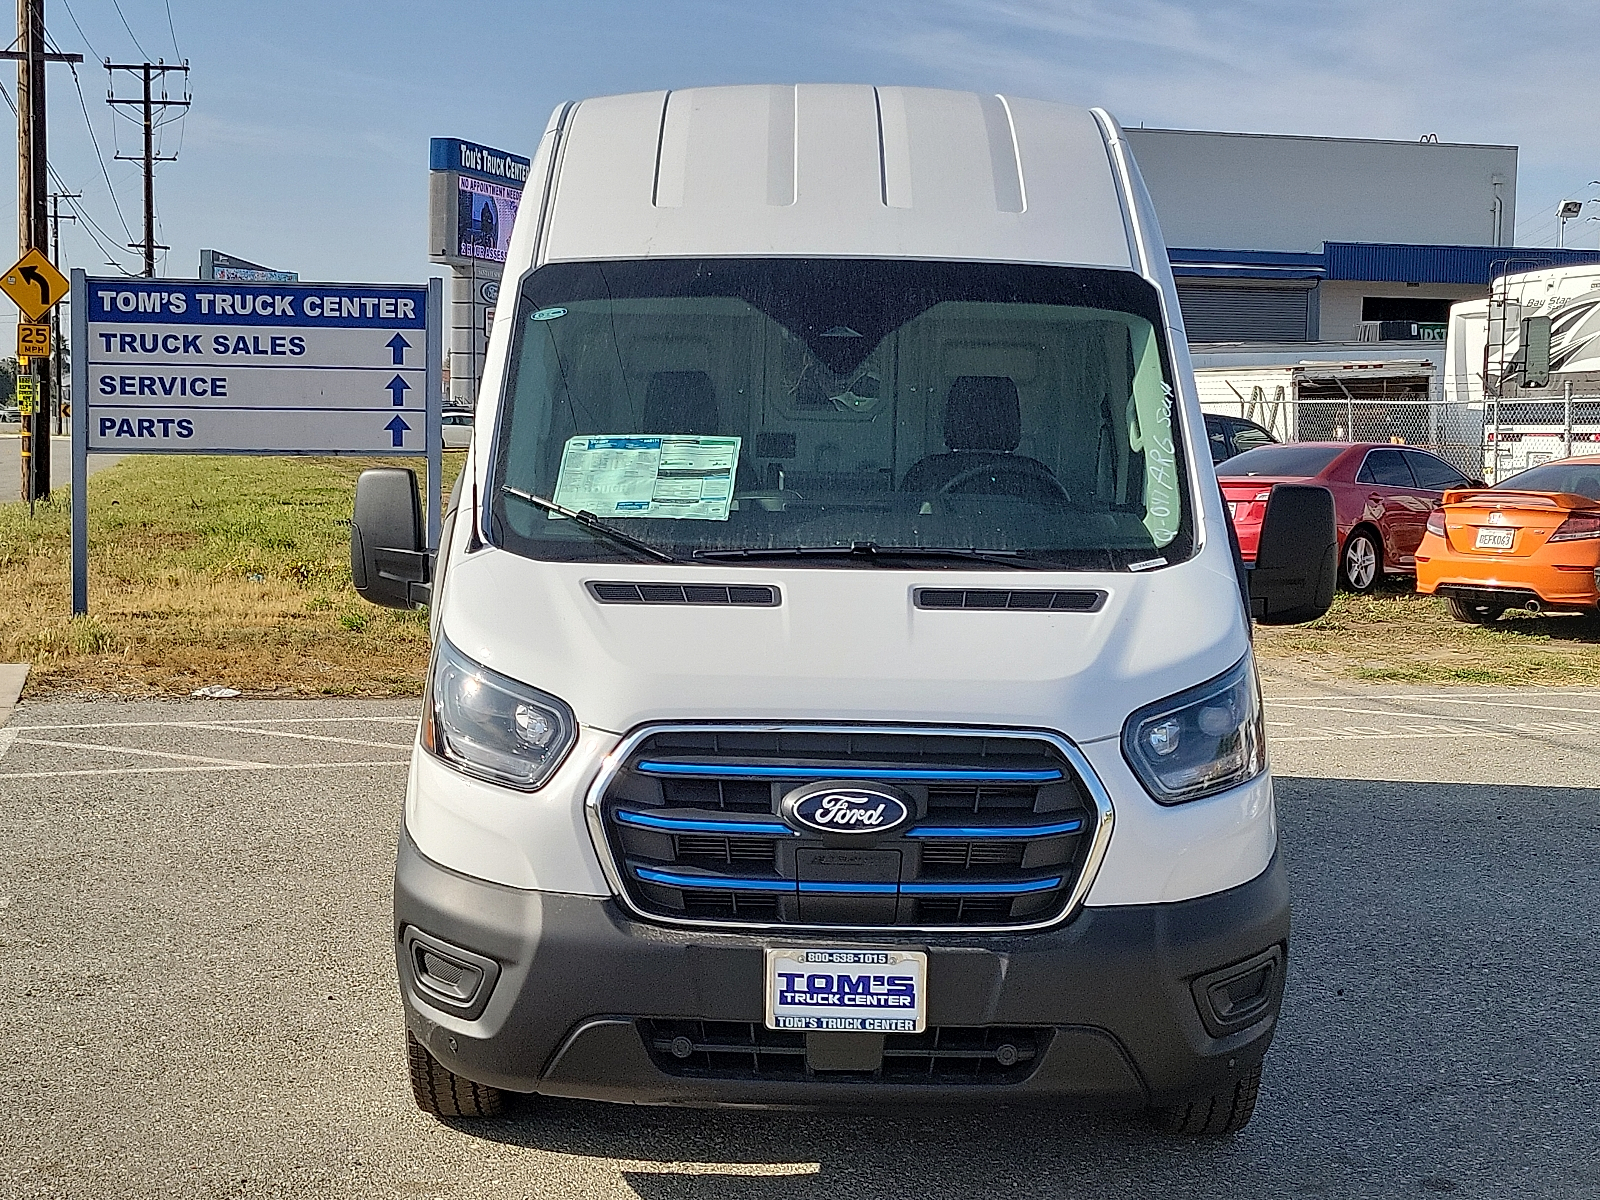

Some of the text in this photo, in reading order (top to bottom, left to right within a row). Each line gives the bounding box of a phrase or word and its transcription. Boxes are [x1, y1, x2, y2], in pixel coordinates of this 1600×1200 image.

[461, 144, 481, 171] TOM'S
[483, 151, 505, 177] TRUCK
[461, 178, 469, 188] NO
[470, 179, 505, 197] APPOINTMENT
[98, 291, 416, 319] TOM'S TRUCK CENTER
[1527, 298, 1546, 308] Bay
[1549, 296, 1571, 306] Star
[21, 327, 48, 344] 25
[99, 332, 306, 356] TRUCK SALES
[24, 345, 44, 354] MPH
[99, 375, 228, 397] SERVICE
[99, 417, 194, 438] PARTS
[814, 794, 886, 825] Ford
[807, 952, 886, 963] 800-638-1015
[777, 972, 915, 995] TOM'S
[784, 992, 911, 1007] TRUCK CENTER
[777, 1017, 914, 1031] TOM'S TRUCK CENTER
